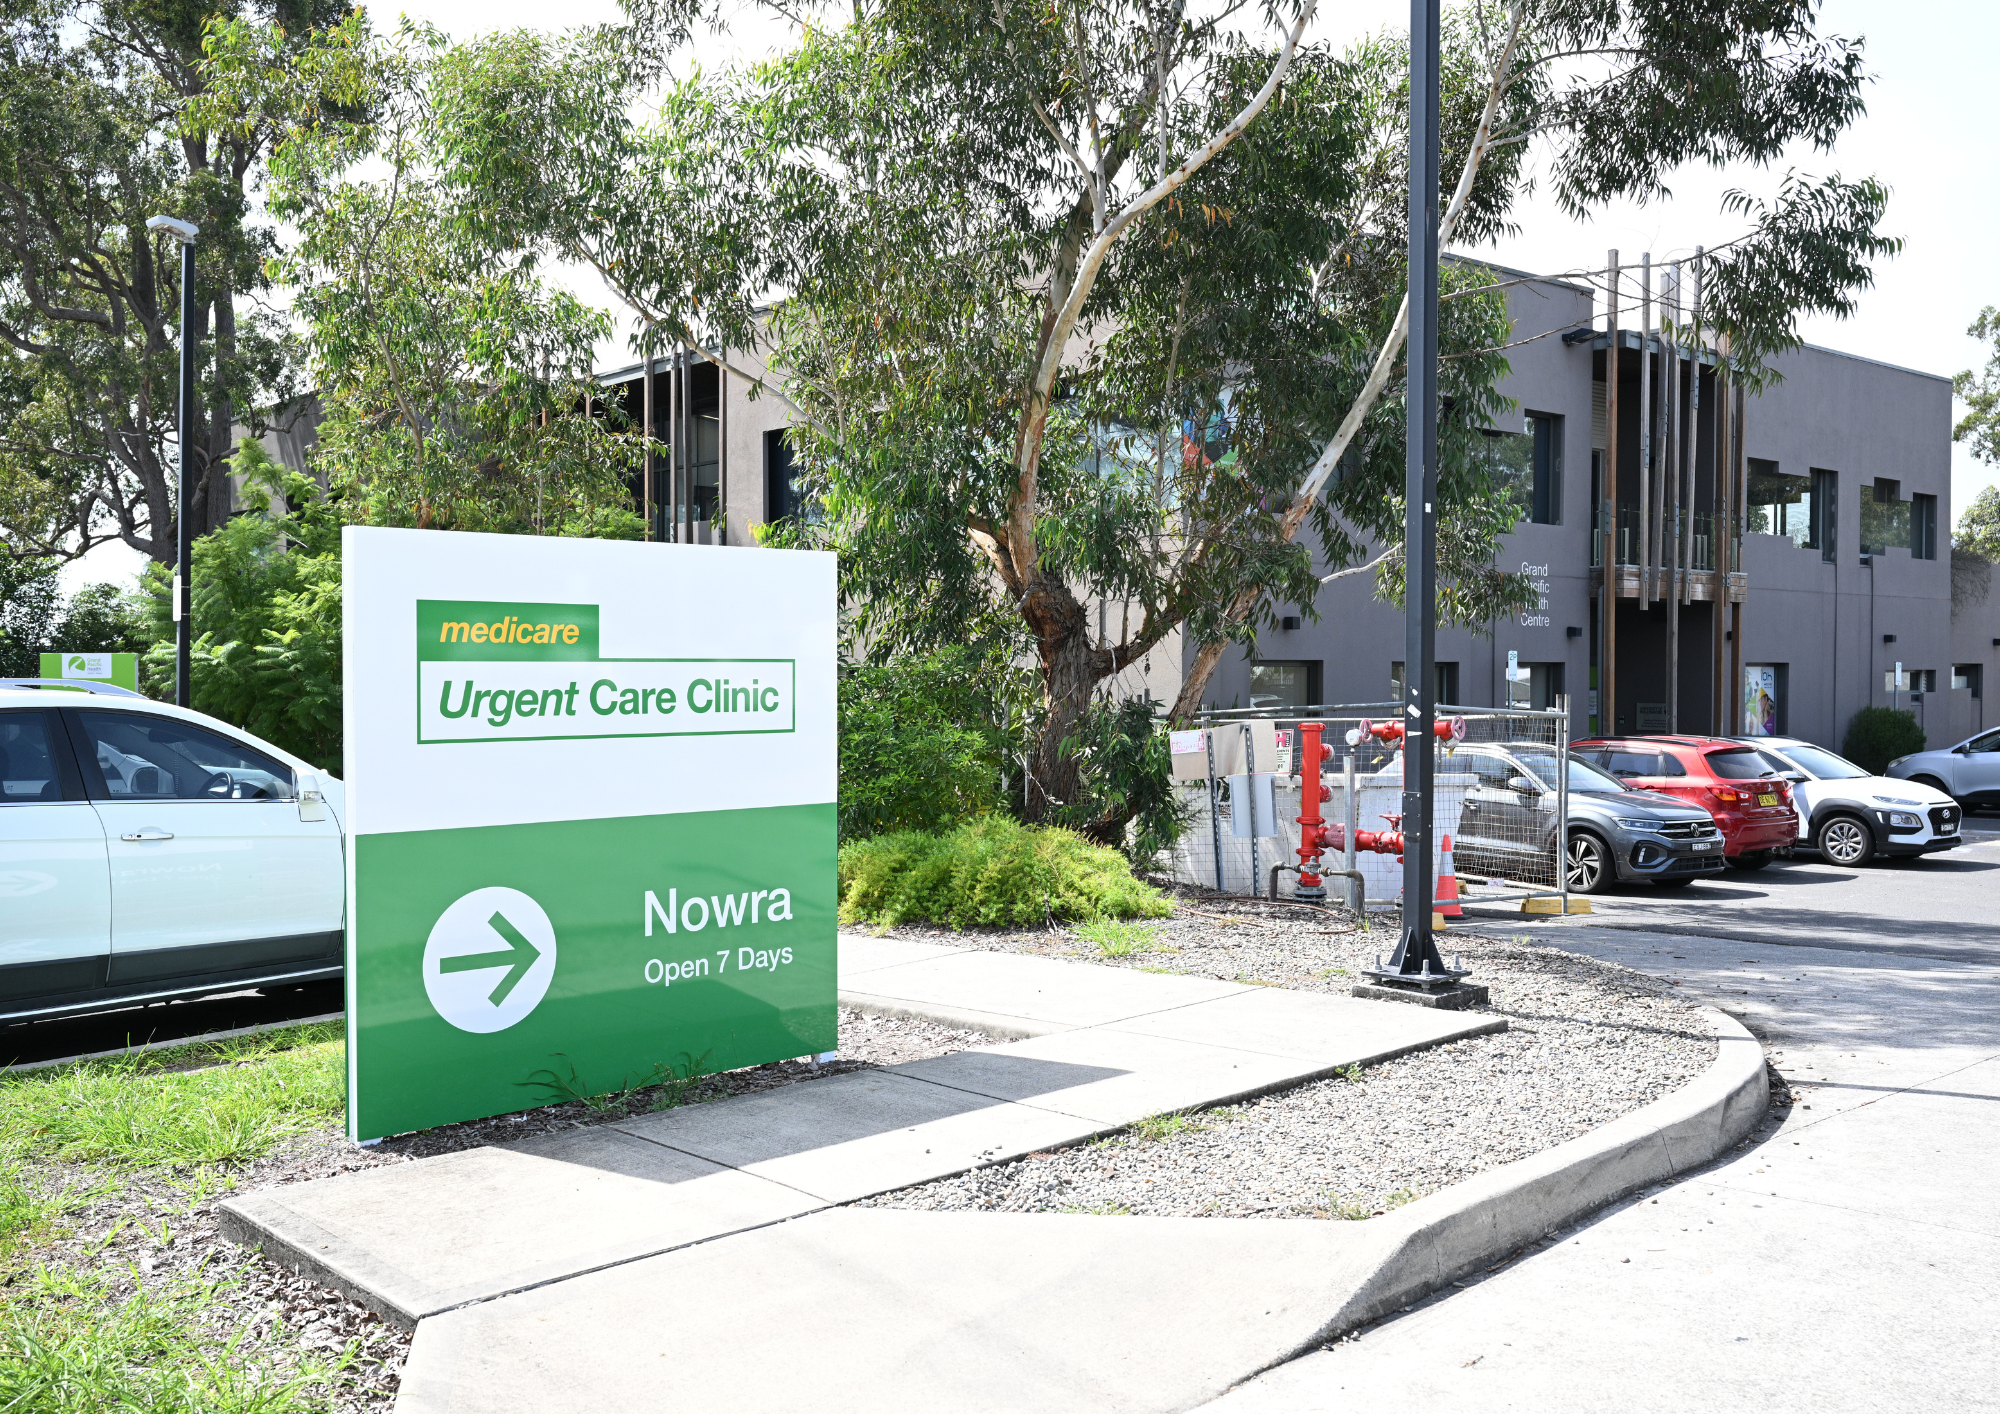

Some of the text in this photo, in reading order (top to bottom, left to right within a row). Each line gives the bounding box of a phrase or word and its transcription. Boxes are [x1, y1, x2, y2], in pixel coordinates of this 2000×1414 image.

[1521, 561, 1548, 576] Grand
[440, 616, 580, 645] medicare
[1521, 612, 1550, 627] Centre
[439, 678, 779, 728] Urgent Care Clinic
[645, 887, 793, 937] Nowra
[644, 946, 793, 987] Open 7 Days
